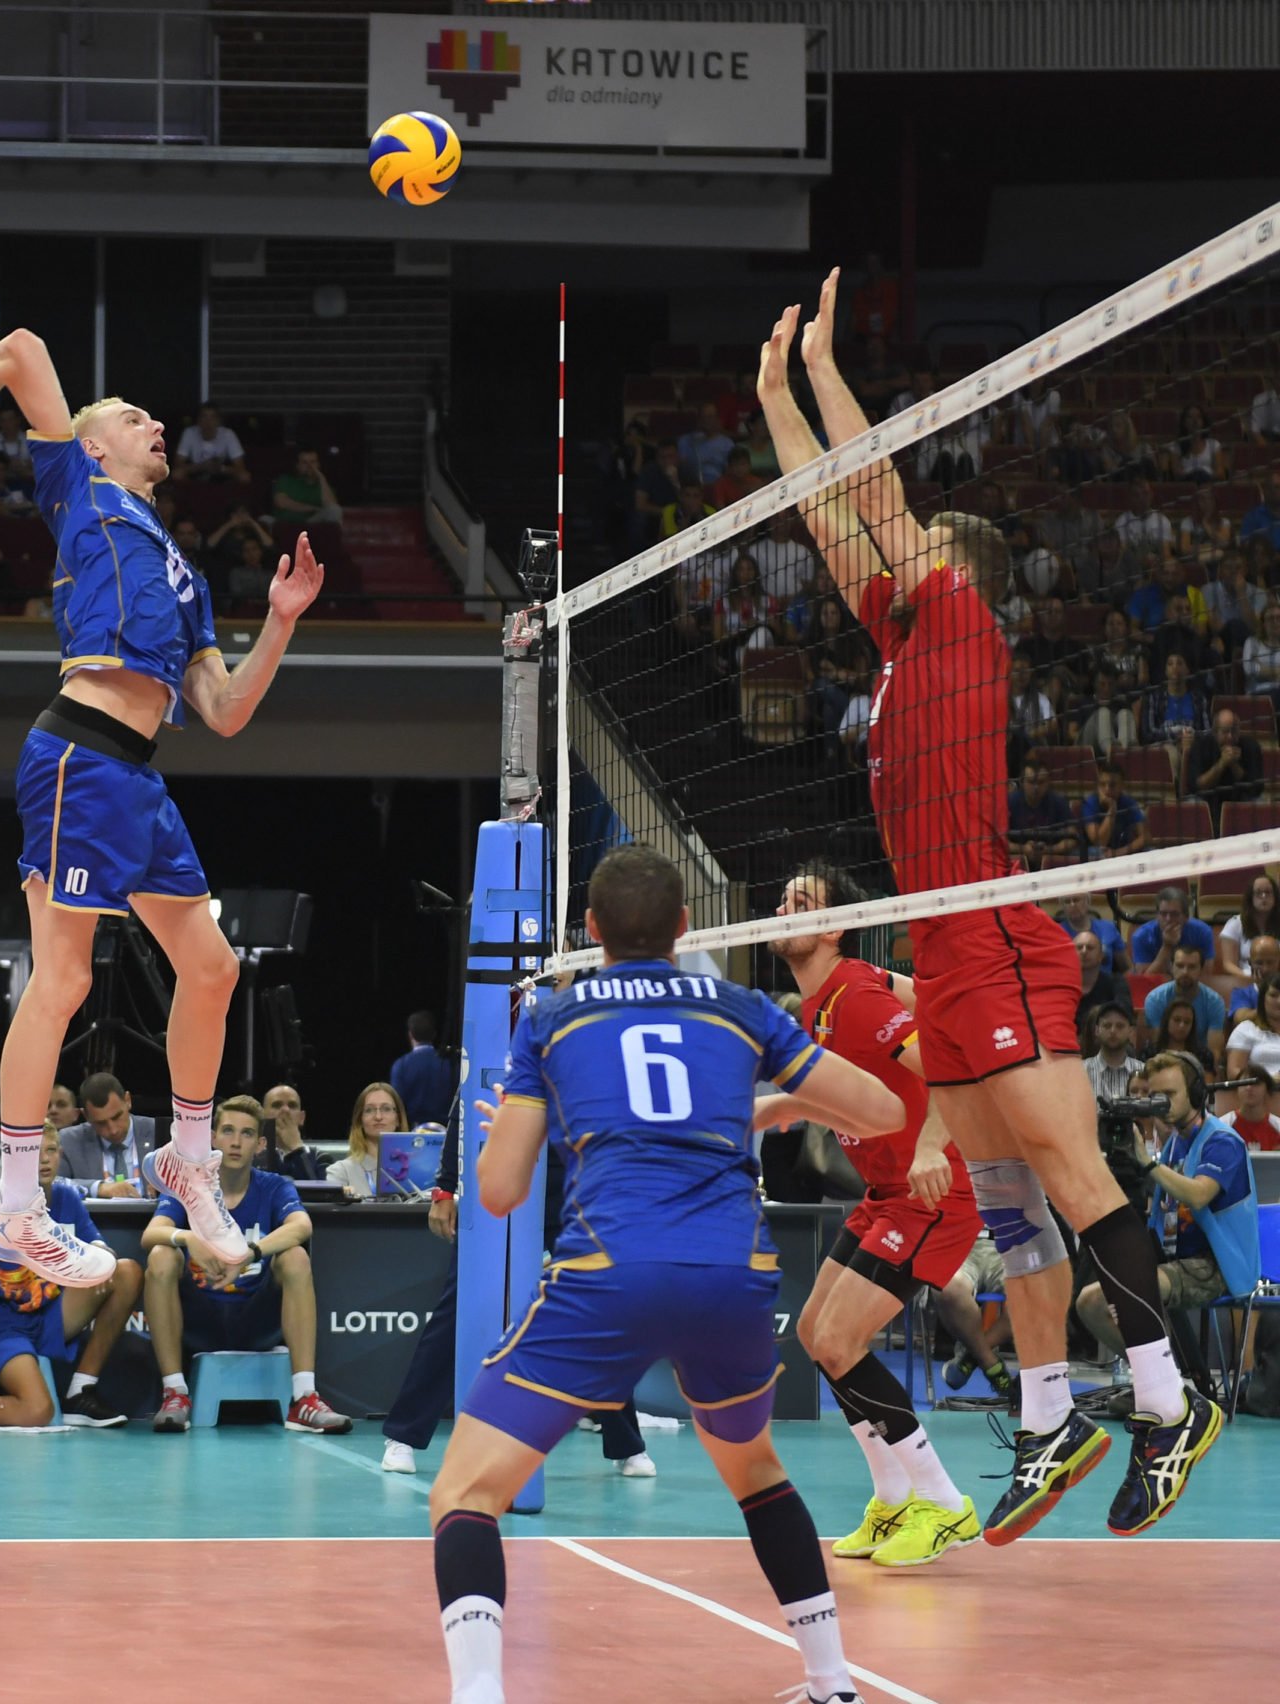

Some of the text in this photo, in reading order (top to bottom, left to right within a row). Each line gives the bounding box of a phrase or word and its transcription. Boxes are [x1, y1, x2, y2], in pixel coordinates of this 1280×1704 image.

[545, 46, 750, 81] KATOWICE
[546, 86, 663, 109] dla odmiany
[64, 866, 89, 896] 10
[620, 1023, 692, 1122] 6
[330, 1311, 418, 1333] LOTTO
